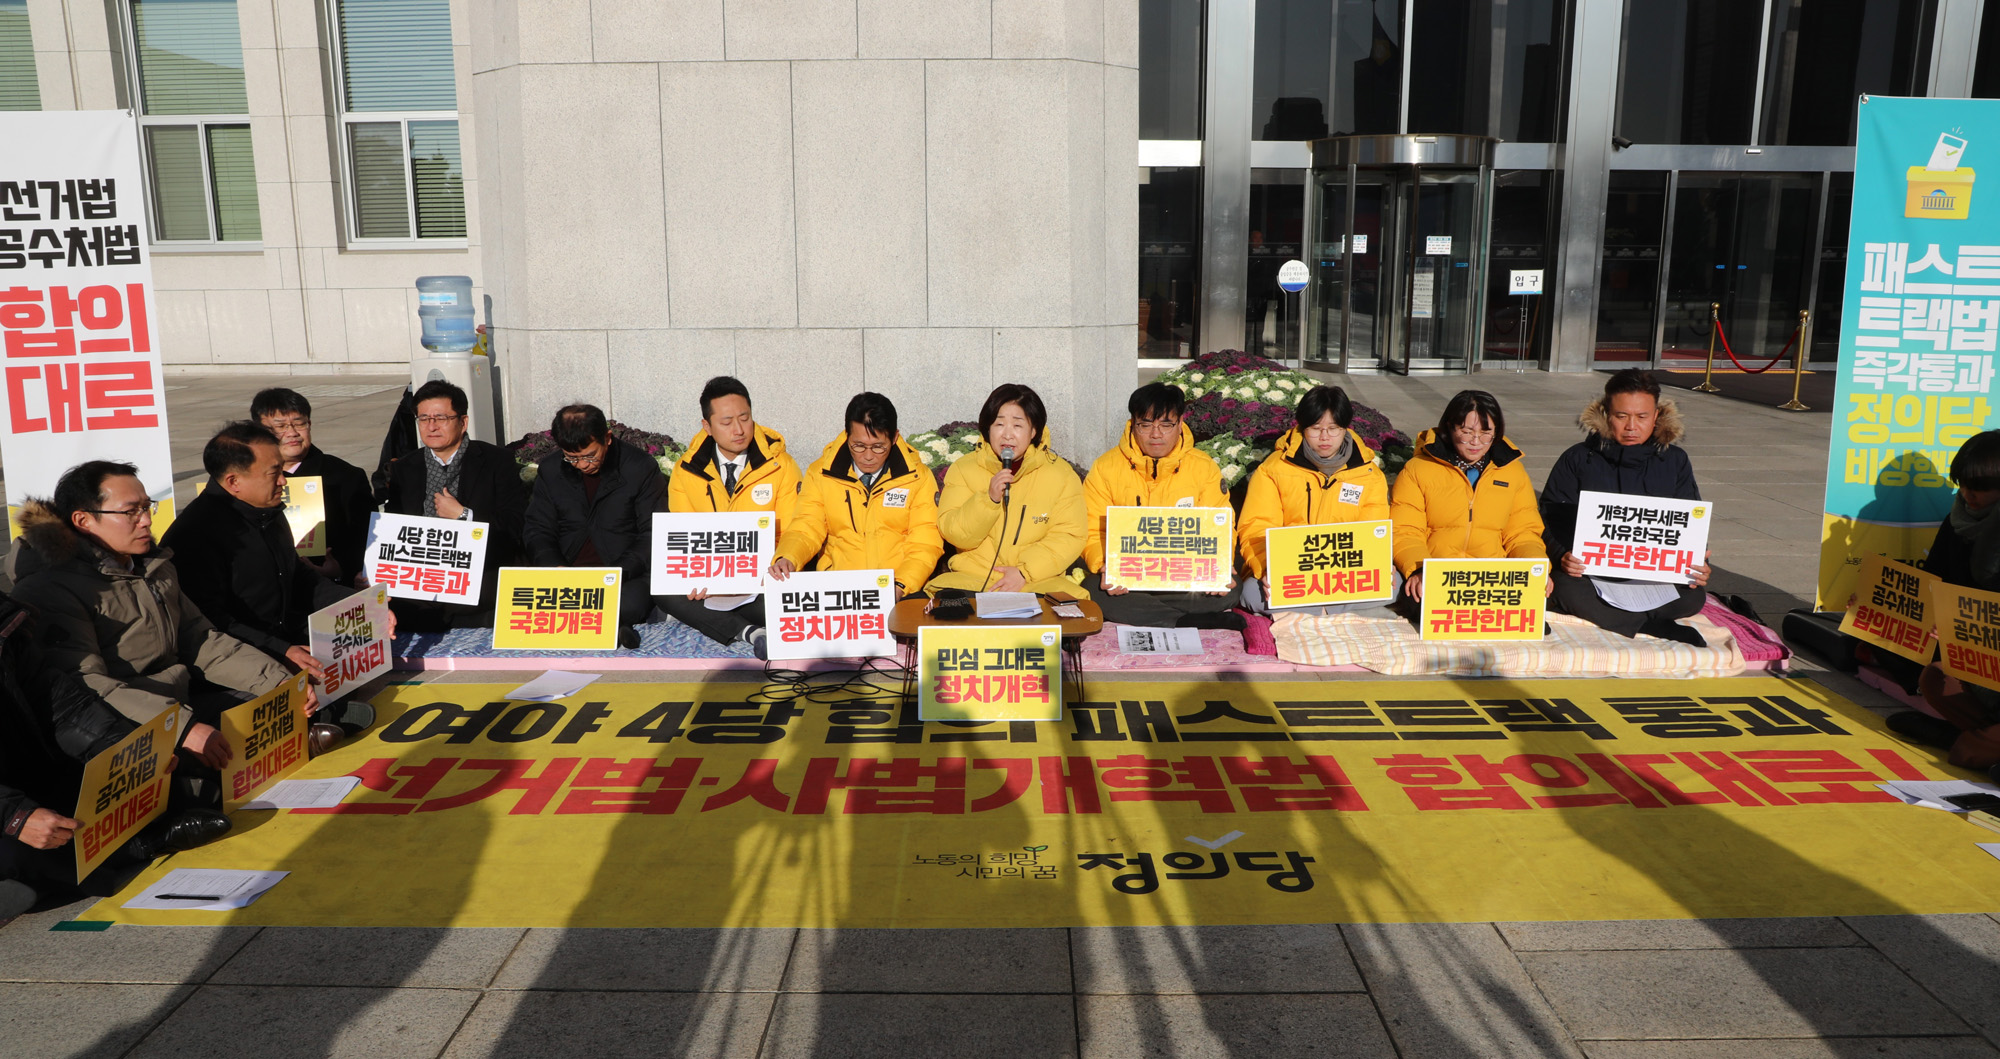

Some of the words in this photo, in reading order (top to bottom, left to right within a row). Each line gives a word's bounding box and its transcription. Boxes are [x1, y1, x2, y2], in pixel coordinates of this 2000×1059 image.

[0, 178, 117, 221] 선거법
[0, 225, 141, 269] 공수처법
[1861, 242, 2000, 296] 패스트
[0, 283, 151, 358] 합의
[1855, 296, 2000, 352] 트랙법
[1853, 350, 1996, 393] 즉각통과
[5, 361, 159, 434] 대로
[1847, 393, 1992, 447] 정의당
[1844, 448, 1960, 488] 비상행
[886, 492, 907, 502] 정의당
[1342, 488, 1361, 499] 정의당
[1137, 516, 1164, 535] 4당
[1167, 516, 1200, 535] 합의
[1597, 504, 1689, 528] 개혁거부세력
[397, 526, 423, 545] 4당
[426, 528, 458, 548] 합의
[667, 531, 758, 554] 특권철폐
[1120, 536, 1217, 555] 패스트트랙법
[1303, 532, 1353, 552] 선거법
[1600, 524, 1681, 546] 자유한국당
[379, 543, 472, 569] 패스트트랙법
[666, 555, 758, 578] 국회개혁
[1119, 557, 1219, 582] 즉각통과
[1298, 550, 1363, 571] 공수처법
[1582, 541, 1694, 575] 규탄한다!
[375, 563, 470, 596] 즉각통과
[1283, 569, 1380, 599] 동시처리
[1442, 571, 1529, 587] 개혁거부세력
[1882, 565, 1920, 597] 선거법
[512, 587, 604, 610] 특권철폐
[782, 591, 820, 613] 민심
[824, 589, 880, 611] 그대로
[1447, 590, 1522, 606] 자유한국당
[1872, 585, 1924, 622] 공수처법
[1958, 595, 2000, 627] 선거법
[334, 604, 365, 636] 선거법
[510, 611, 603, 635] 국회개혁
[779, 613, 885, 642] 정치개혁
[1431, 609, 1536, 633] 규탄한다!
[1852, 605, 1931, 655] 합의대로!
[1953, 618, 2000, 652] 공수처
[332, 622, 373, 659] 공수처법
[324, 639, 384, 695] 동시처리
[938, 648, 978, 671] 민심
[984, 648, 1045, 671] 그대로
[934, 674, 1049, 703] 정치개혁
[253, 689, 290, 731] 선거법
[378, 701, 612, 744] 여야
[616, 701, 804, 744] 4당
[1070, 698, 1618, 743] 패스트트랙
[1600, 695, 1853, 739] 통과
[245, 710, 294, 760] 공수처법
[108, 729, 154, 781] 선거법
[233, 733, 302, 800] 합의대로!
[95, 753, 158, 815] 공수처법
[1373, 748, 1931, 811] 합의대로!
[82, 778, 163, 864] 합의대로!
[912, 853, 980, 866] 노동의
[987, 852, 1041, 866] 희망
[956, 866, 1025, 879] 시민의
[1030, 865, 1059, 879] 꿈
[1076, 851, 1316, 895] 정의당
